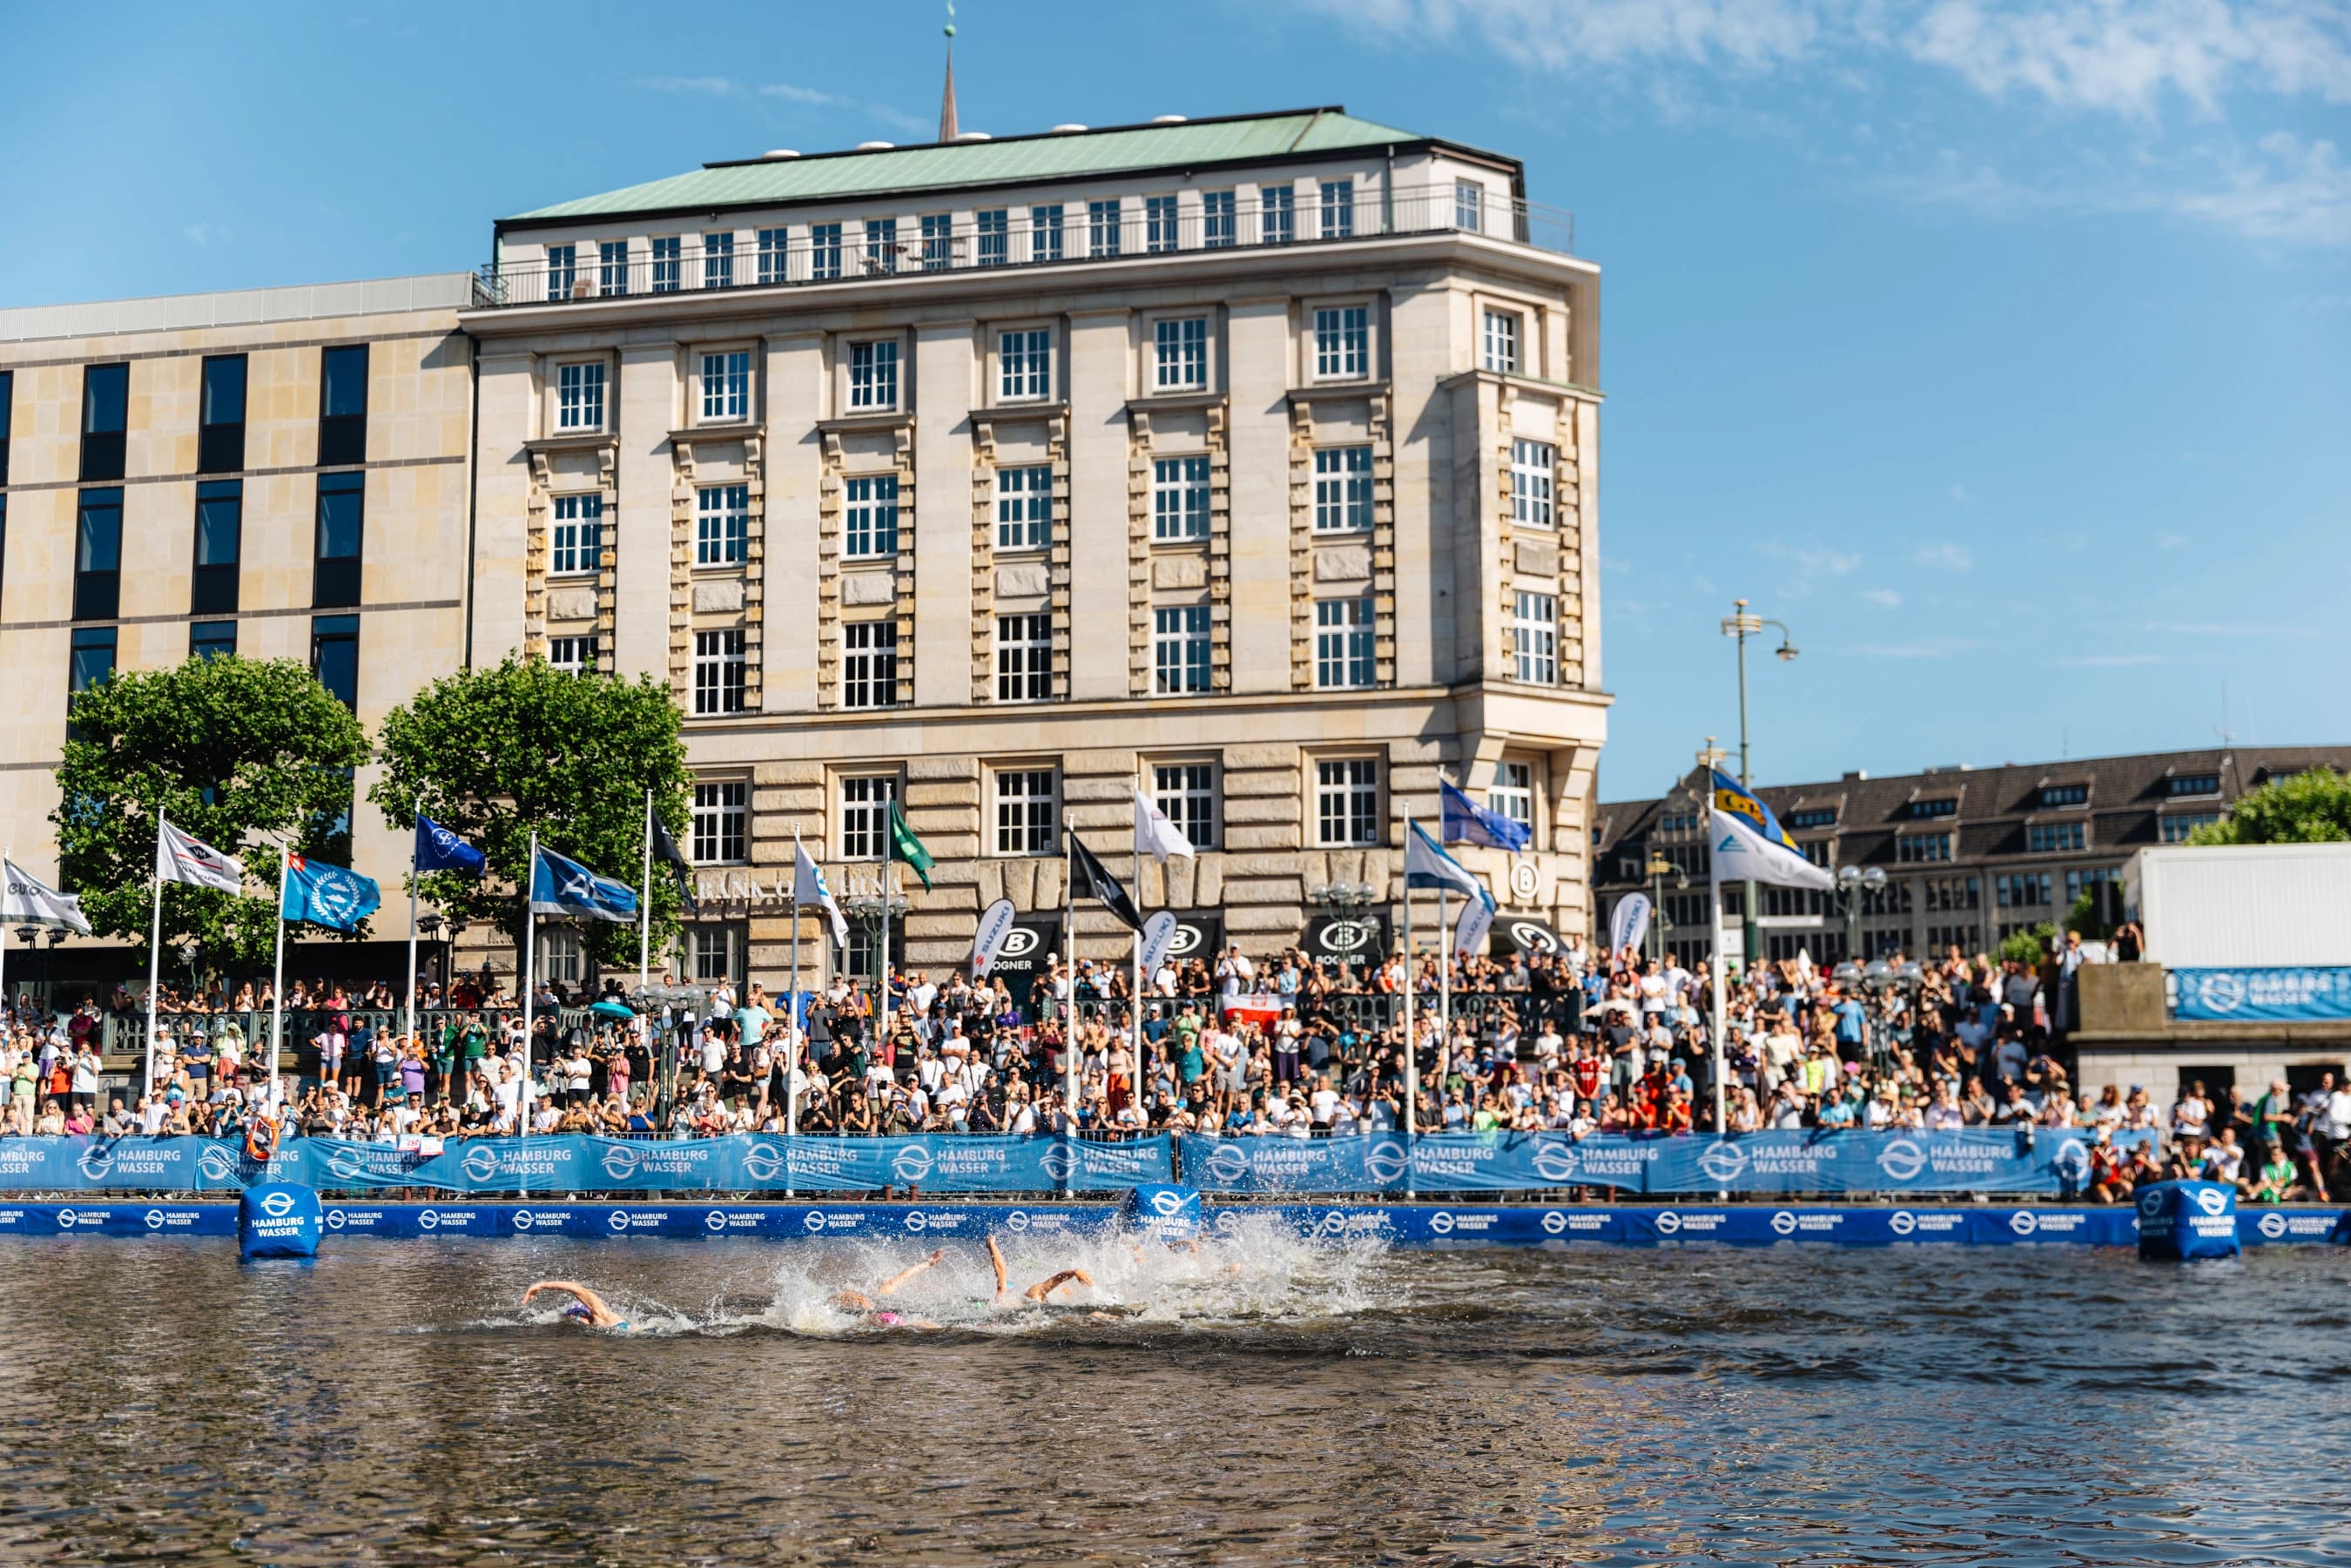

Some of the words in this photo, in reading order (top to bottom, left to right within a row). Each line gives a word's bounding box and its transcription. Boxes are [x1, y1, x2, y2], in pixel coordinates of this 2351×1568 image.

[193, 847, 206, 858] VM
[698, 878, 765, 899] BANK
[776, 879, 795, 898] O
[830, 877, 906, 896] HINA
[981, 905, 1010, 953] SUZUKI
[1463, 907, 1486, 946] SUZU
[1144, 917, 1172, 963] SUZUKI
[992, 960, 1032, 971] OGNER
[1316, 954, 1366, 966] BOGER
[0, 1151, 45, 1162] MBURG
[118, 1150, 181, 1161] HAMBURG
[236, 1150, 300, 1162] HURG
[367, 1152, 428, 1163] HAMBURG
[502, 1149, 572, 1161] HAMBURG
[641, 1149, 708, 1161] HAMBURG
[786, 1149, 857, 1162] HAMBURG
[937, 1149, 1005, 1161] HAMBURG
[1083, 1147, 1158, 1161] HAMBURG
[1253, 1150, 1327, 1162] HAMBURG
[1414, 1147, 1494, 1160] HAMBURG
[1582, 1148, 1659, 1161] HAMBURG
[1752, 1146, 1837, 1159] HAMBURG
[1930, 1145, 2012, 1159] HAMBURG
[0, 1162, 30, 1174] SSER
[118, 1162, 165, 1174] WASSER
[367, 1164, 414, 1174] WASSER
[503, 1162, 555, 1174] WASSER
[643, 1161, 691, 1173] WASSER
[787, 1162, 840, 1174] WASSER
[938, 1162, 989, 1174] WASSER
[1084, 1161, 1141, 1173] WASSER
[1254, 1162, 1310, 1174] WASSER
[1414, 1161, 1476, 1174] WASSER
[1583, 1161, 1642, 1174] WASSER
[1754, 1160, 1818, 1173] WASSER
[1930, 1159, 1994, 1173] WASSER
[252, 1217, 305, 1228] HAMBURG
[1798, 1215, 1844, 1223] HAMBURG
[1917, 1215, 1964, 1223] HAMBURG
[2038, 1214, 2086, 1223] HAMBURG
[2287, 1216, 2338, 1227] HAMBURG
[258, 1227, 299, 1237] WASSER
[1156, 1227, 1185, 1236] ASSER
[2038, 1222, 2075, 1231] WASSER
[2197, 1227, 2233, 1237] WASSER
[2288, 1226, 2327, 1235] WASSER
